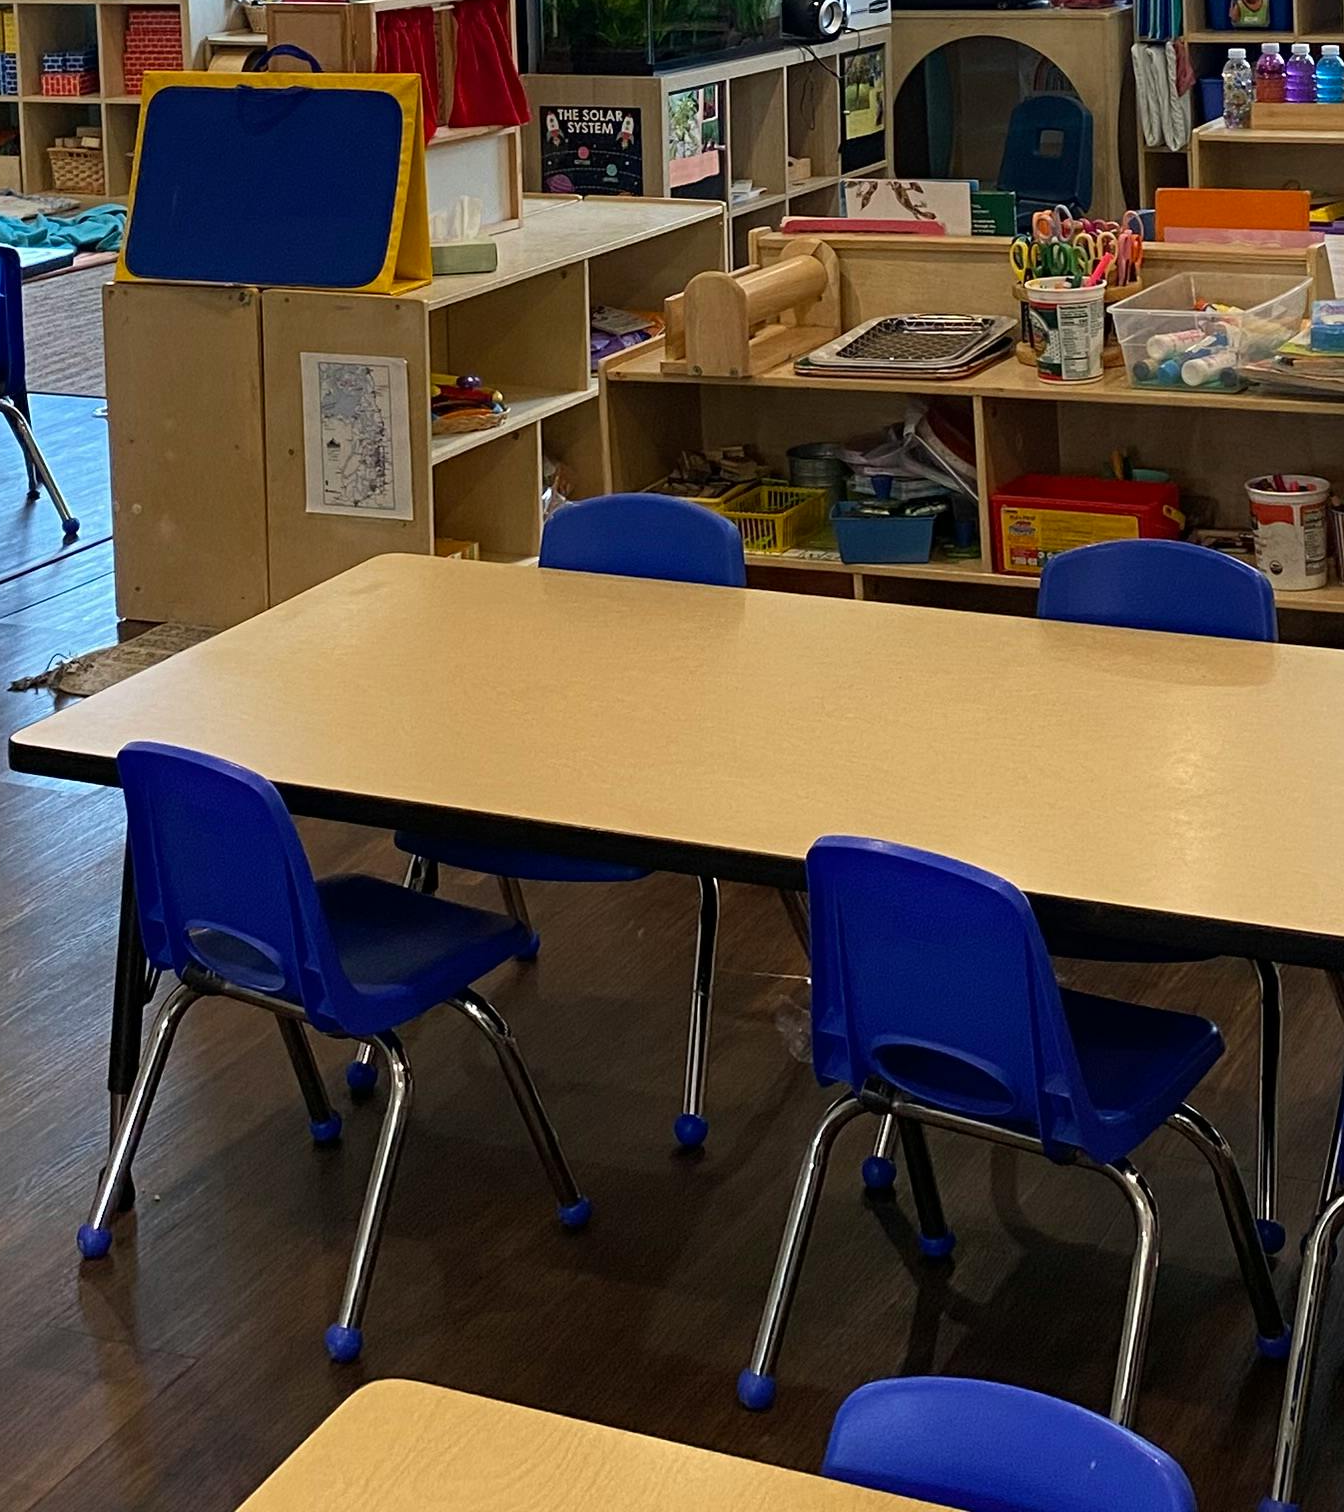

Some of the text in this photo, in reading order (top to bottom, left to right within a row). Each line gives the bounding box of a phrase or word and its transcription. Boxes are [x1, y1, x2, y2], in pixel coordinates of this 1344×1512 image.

[557, 109, 623, 122] THE SOLAR
[567, 121, 614, 135] SYSTEM
